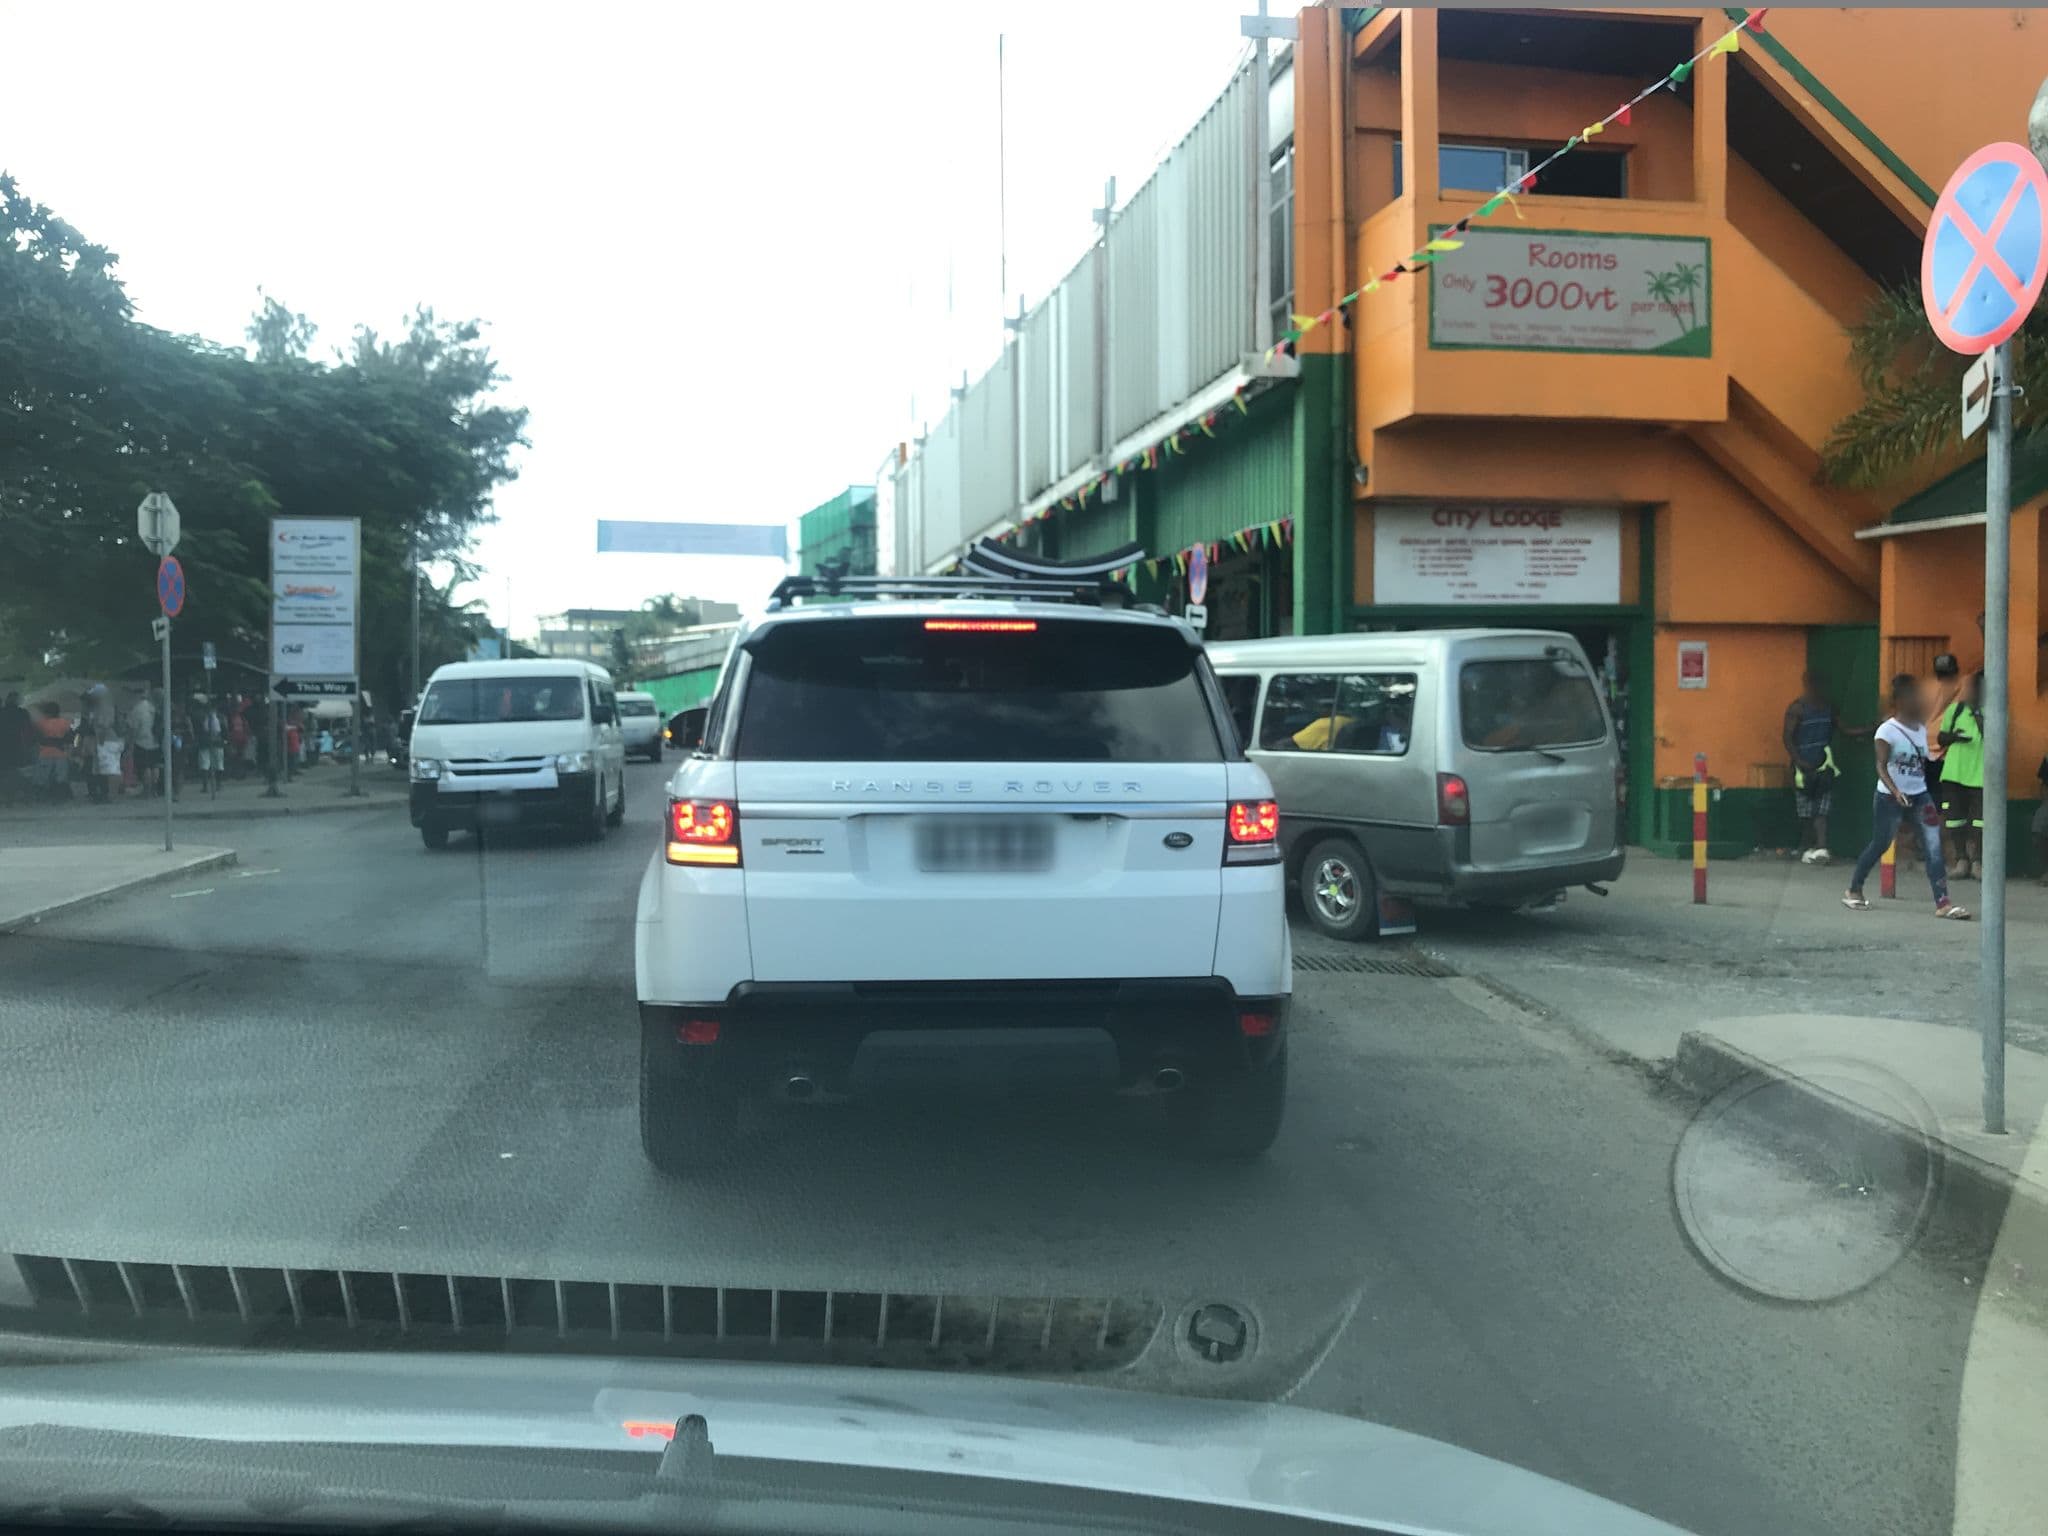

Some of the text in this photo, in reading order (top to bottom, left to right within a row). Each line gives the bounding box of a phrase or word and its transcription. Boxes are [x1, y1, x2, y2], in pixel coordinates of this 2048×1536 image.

[1528, 243, 1618, 270] Rooms
[1442, 273, 1619, 312] Only 3000vt
[1489, 508, 1563, 530] LODGE
[297, 683, 348, 694] This Way
[832, 780, 1142, 793] RANGE ROVER
[761, 838, 825, 847] SPORT
